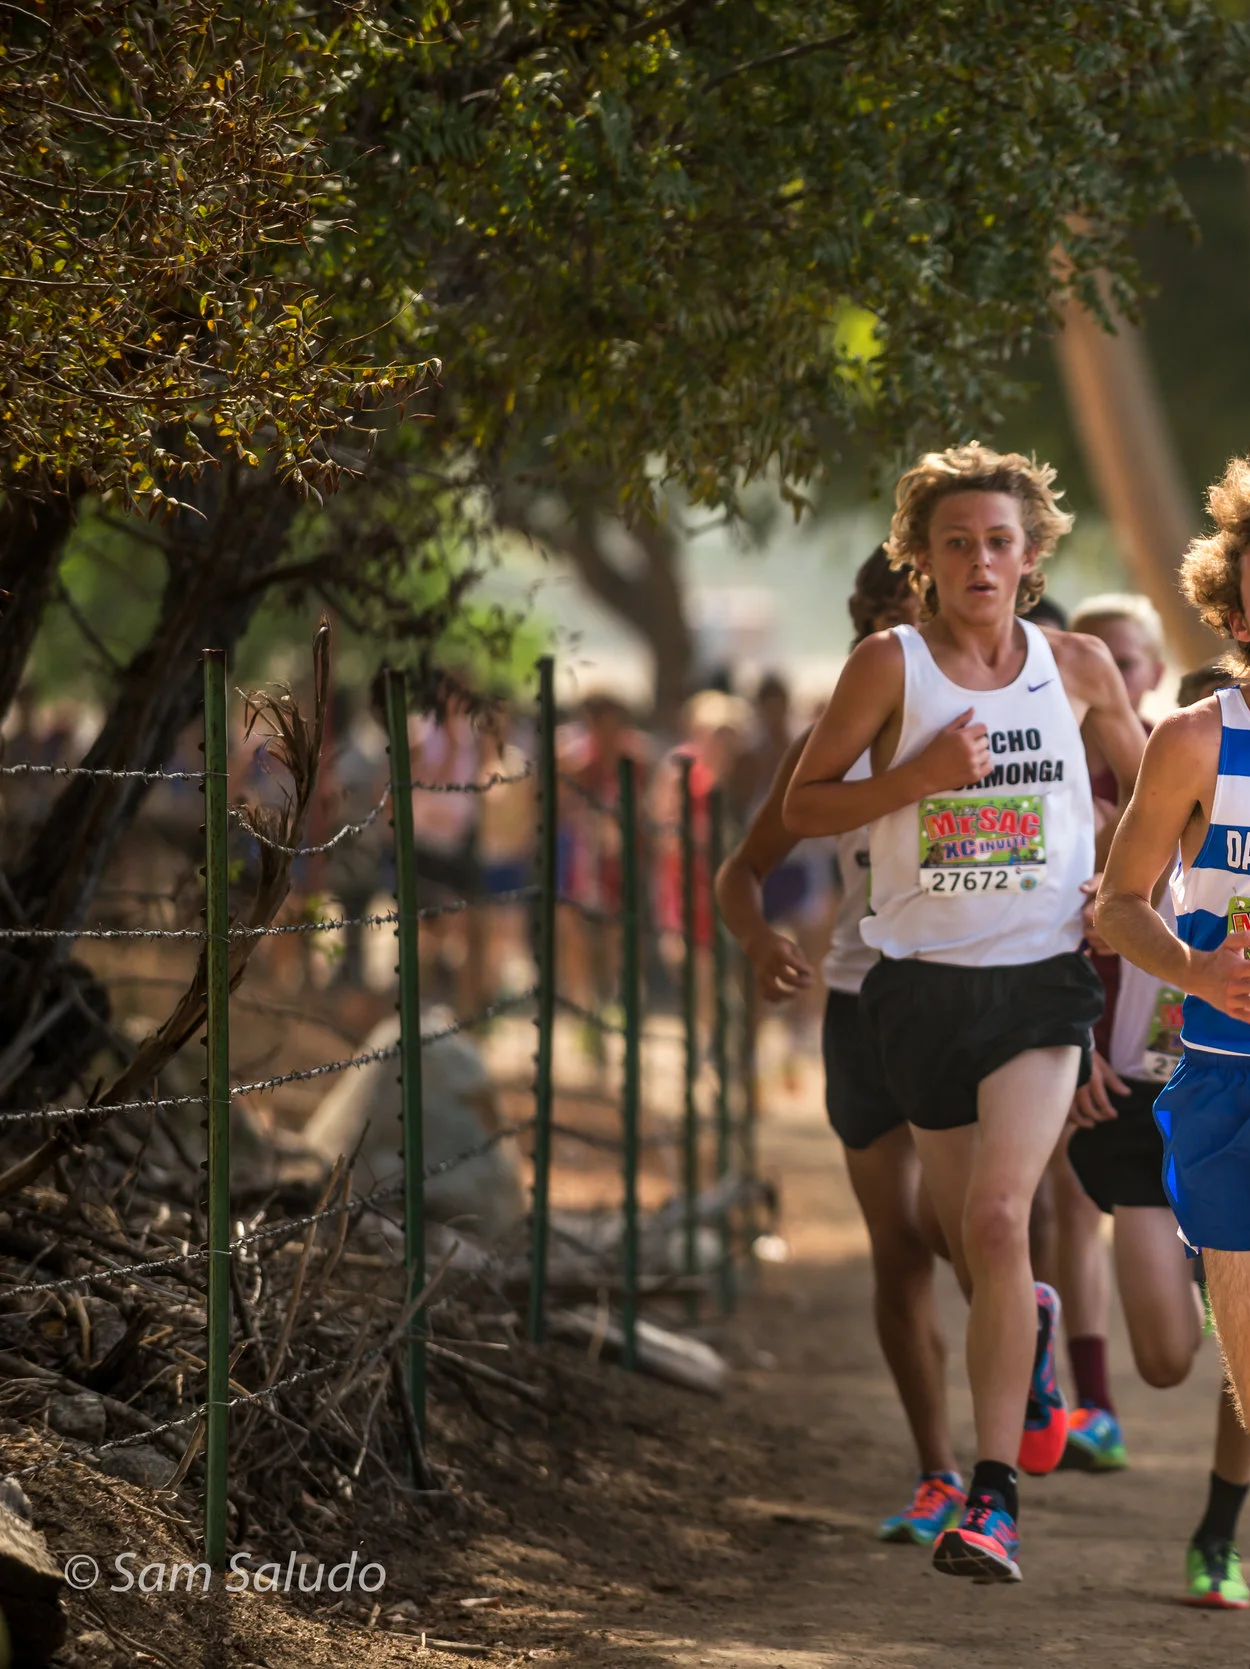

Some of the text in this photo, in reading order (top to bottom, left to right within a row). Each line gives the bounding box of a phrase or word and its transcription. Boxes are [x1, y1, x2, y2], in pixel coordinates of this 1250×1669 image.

[986, 728, 1042, 754] CHO
[955, 759, 1064, 791] MONGA
[944, 836, 1028, 859] XC INVITE
[932, 870, 1009, 892] 27672
